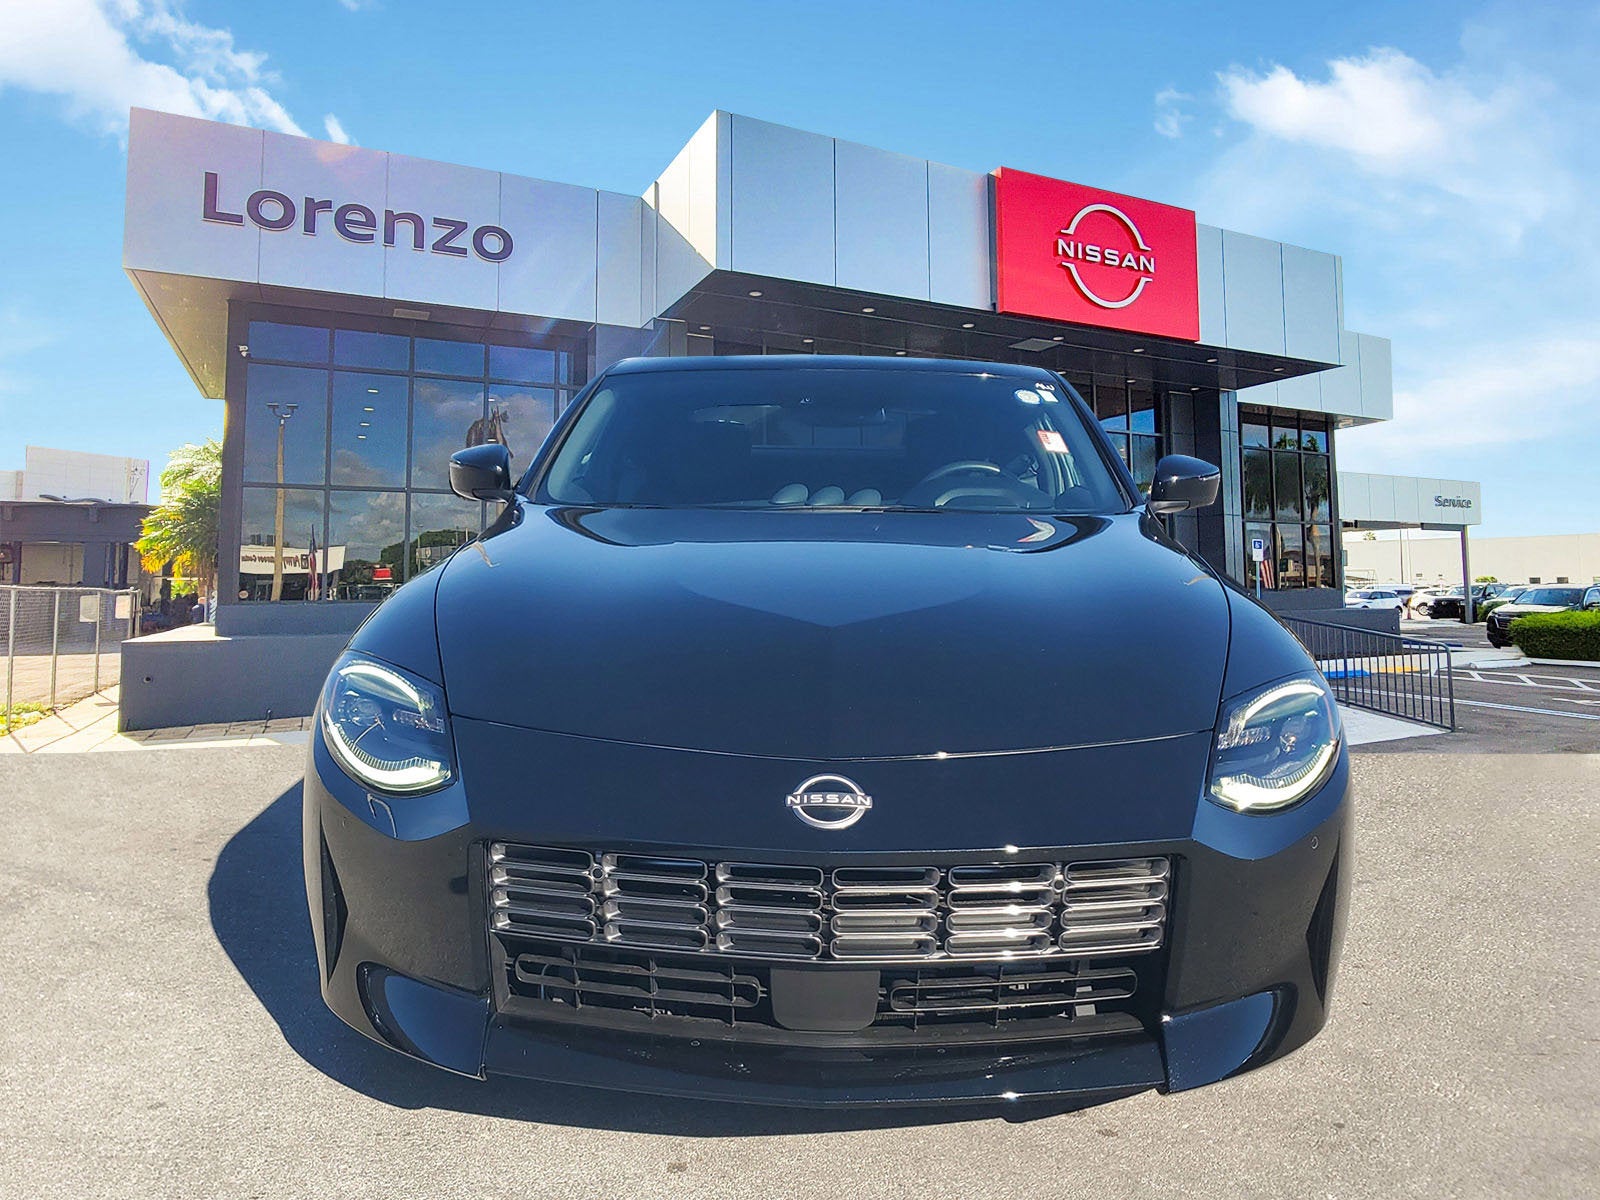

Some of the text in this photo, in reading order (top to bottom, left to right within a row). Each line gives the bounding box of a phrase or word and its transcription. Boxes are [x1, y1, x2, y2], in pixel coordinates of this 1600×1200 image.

[202, 171, 514, 262] Lorenzo
[1057, 238, 1155, 273] NISSAN
[1434, 495, 1472, 509] Service
[787, 794, 871, 806] NISSAN
